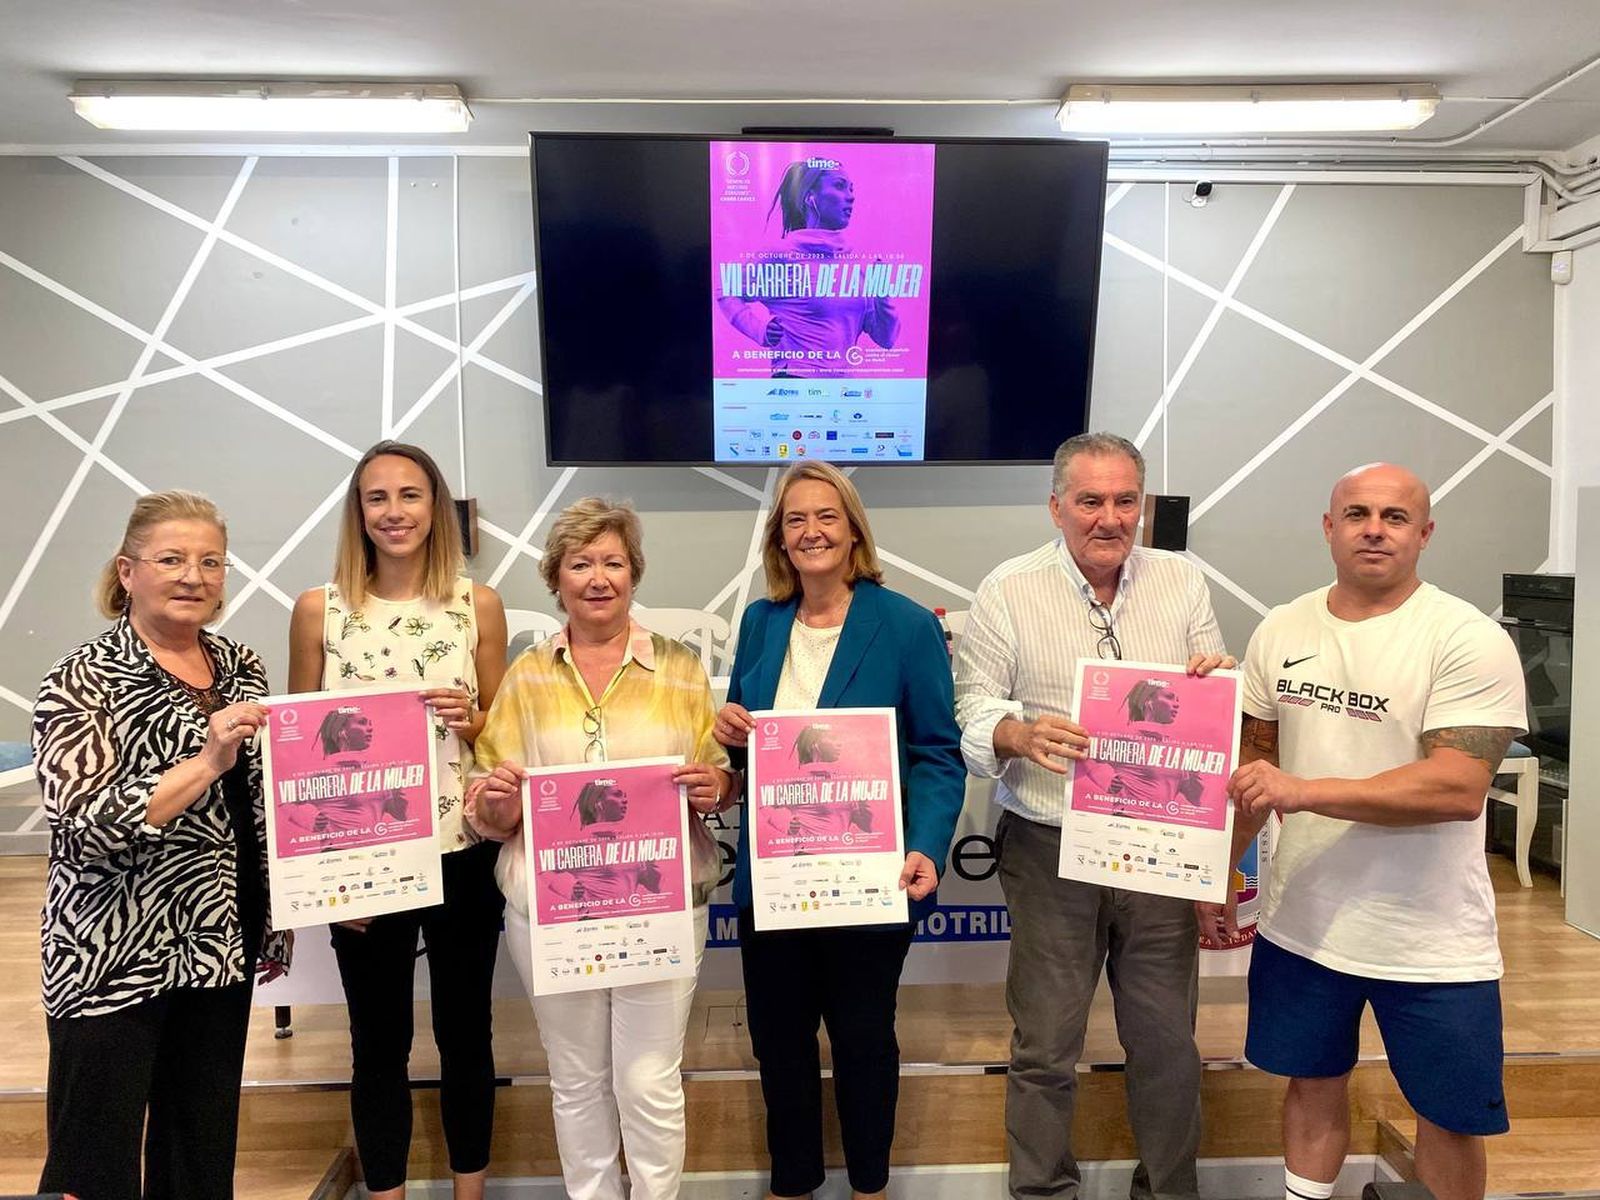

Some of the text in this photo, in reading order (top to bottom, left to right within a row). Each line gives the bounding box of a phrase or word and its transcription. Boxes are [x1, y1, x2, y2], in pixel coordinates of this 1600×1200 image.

[719, 263, 924, 298] VII CARRERA DE LA MUJER
[731, 350, 841, 360] A BENEFICIO DE LA
[1276, 679, 1391, 713] BLACK BOX
[1320, 702, 1341, 714] PRO
[1099, 737, 1146, 765] CARRERA
[1147, 744, 1164, 767] DE
[1165, 746, 1180, 770] LA
[1181, 748, 1226, 775] MUJER
[278, 780, 297, 803] VII
[299, 775, 348, 801] CARRERA
[349, 770, 365, 795] DE
[366, 768, 381, 793] LA
[382, 764, 425, 790] MUJER
[776, 782, 819, 806] CARRERA
[820, 782, 834, 804] DE
[836, 781, 849, 803] LA
[850, 780, 888, 801] MUJER
[1085, 792, 1092, 800] A
[1093, 795, 1137, 806] BENEFICIO
[1152, 801, 1164, 809] LA
[299, 831, 345, 843] BENEFICIO
[346, 829, 358, 837] DE
[360, 827, 372, 835] LA
[775, 836, 815, 845] BENEFICIO
[539, 849, 555, 871] VII
[556, 843, 603, 870] CARRERA
[605, 841, 620, 866] DE
[621, 840, 636, 864] LA
[636, 837, 678, 862] MUJER
[558, 900, 601, 911] BENEFICIO
[602, 899, 613, 907] DE
[615, 897, 626, 905] LA
